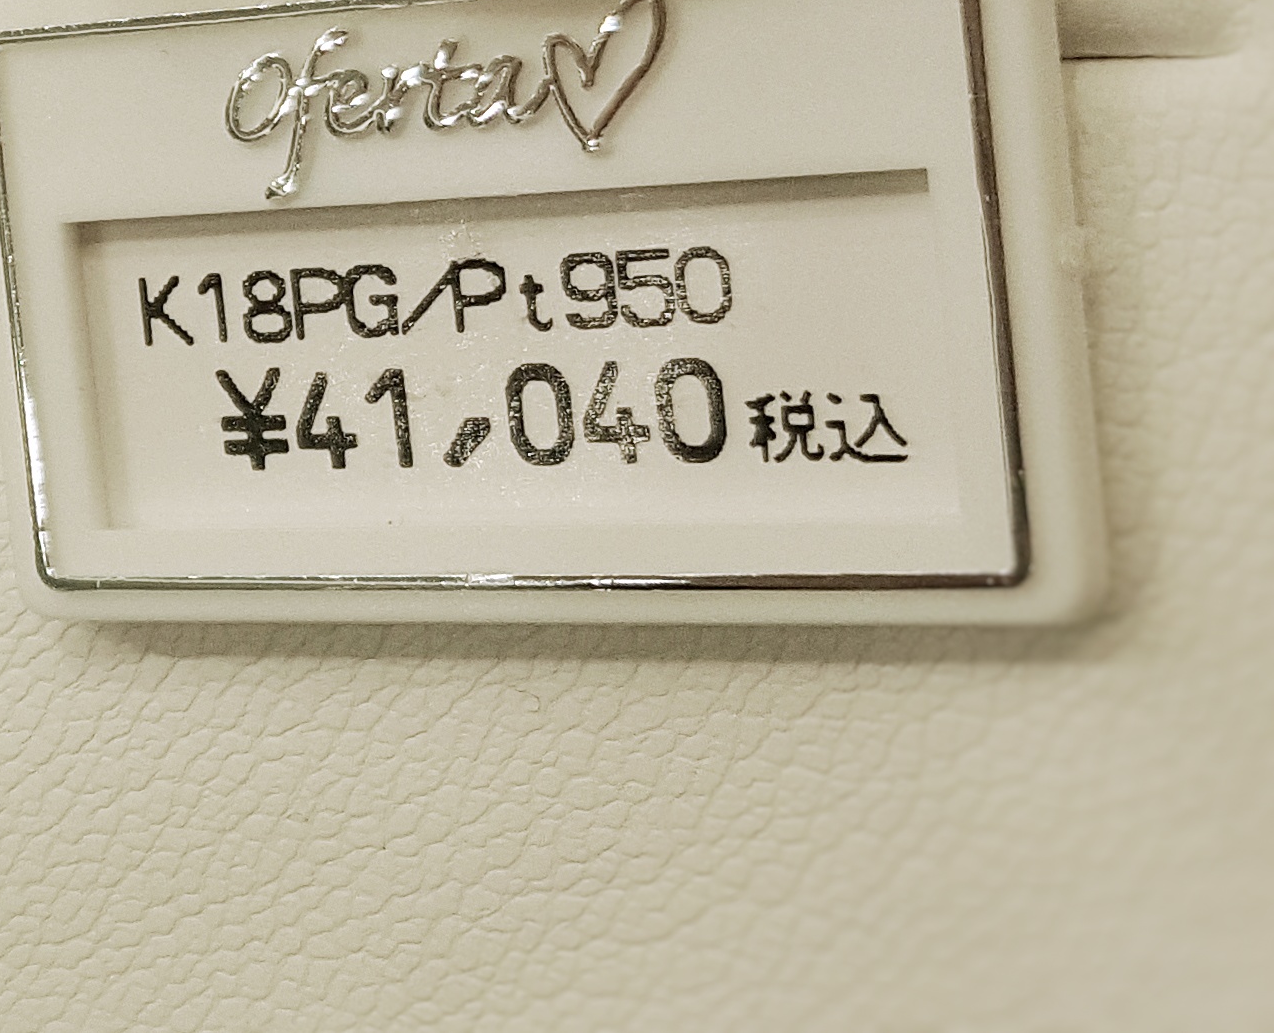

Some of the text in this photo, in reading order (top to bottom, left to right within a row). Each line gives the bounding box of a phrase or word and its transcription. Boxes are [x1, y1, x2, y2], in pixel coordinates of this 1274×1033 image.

[138, 243, 734, 347] K18PG/Pt950
[214, 356, 909, 471] ¥41,040 税込
